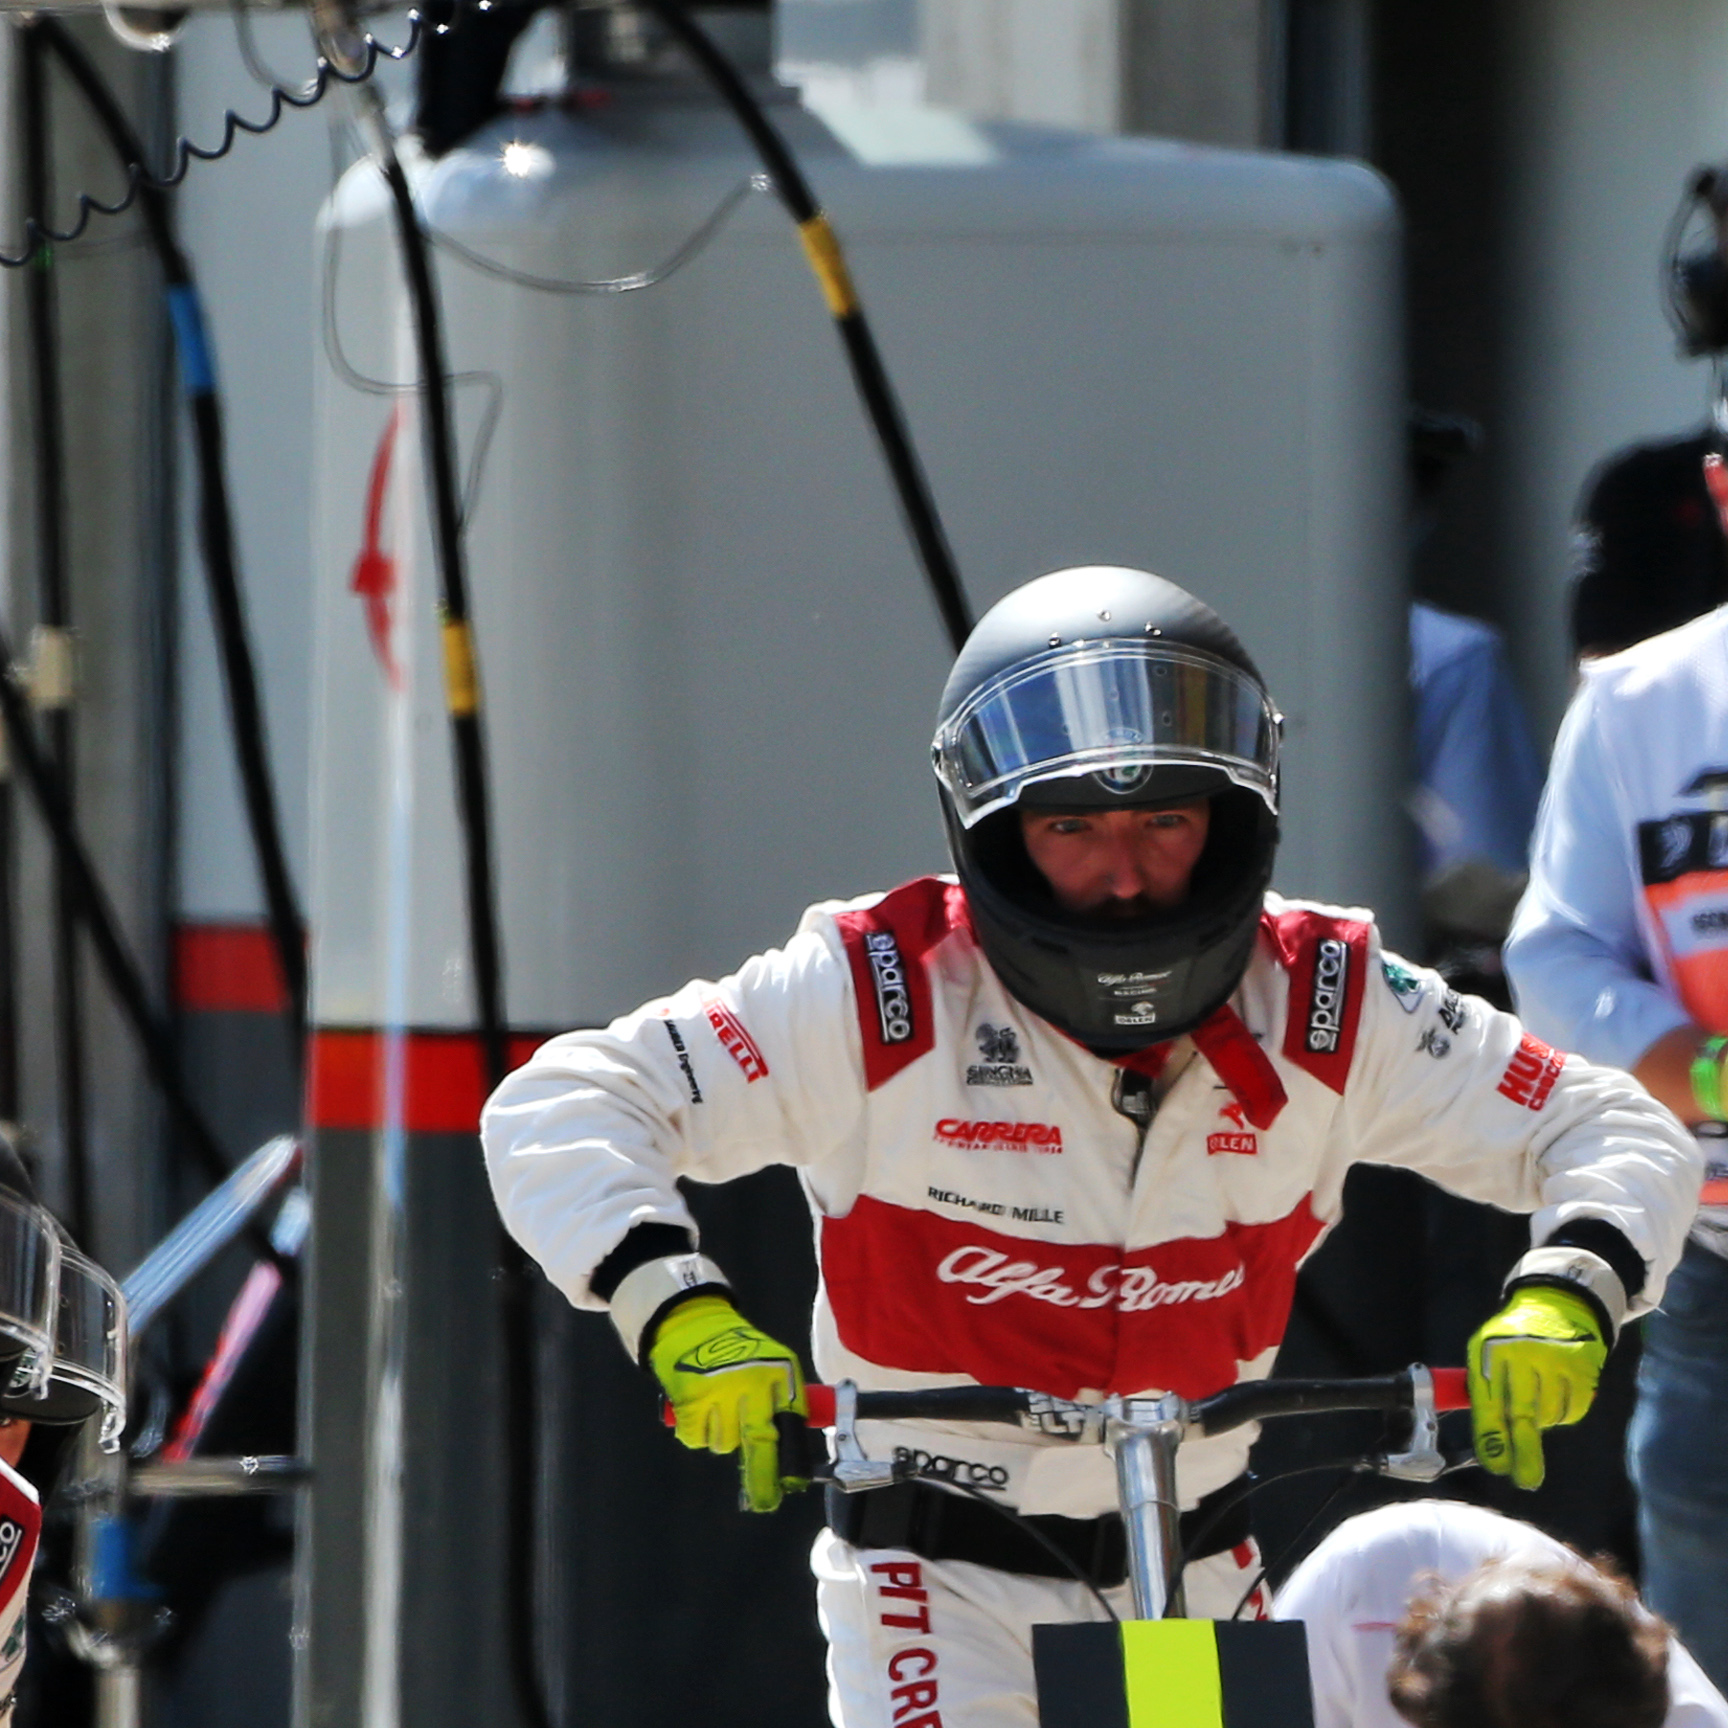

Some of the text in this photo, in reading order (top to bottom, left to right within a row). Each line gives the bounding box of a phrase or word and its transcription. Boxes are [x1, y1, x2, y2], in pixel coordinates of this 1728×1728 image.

[866, 932, 912, 1044] sparco
[1308, 939, 1348, 1052] sparco
[1495, 1031, 1553, 1107] HUS
[935, 1118, 1063, 1147] CARRERA
[927, 1186, 1065, 1225] RICHARD MILLE
[936, 1245, 1081, 1305] Alfa
[869, 1561, 933, 1635] PIT
